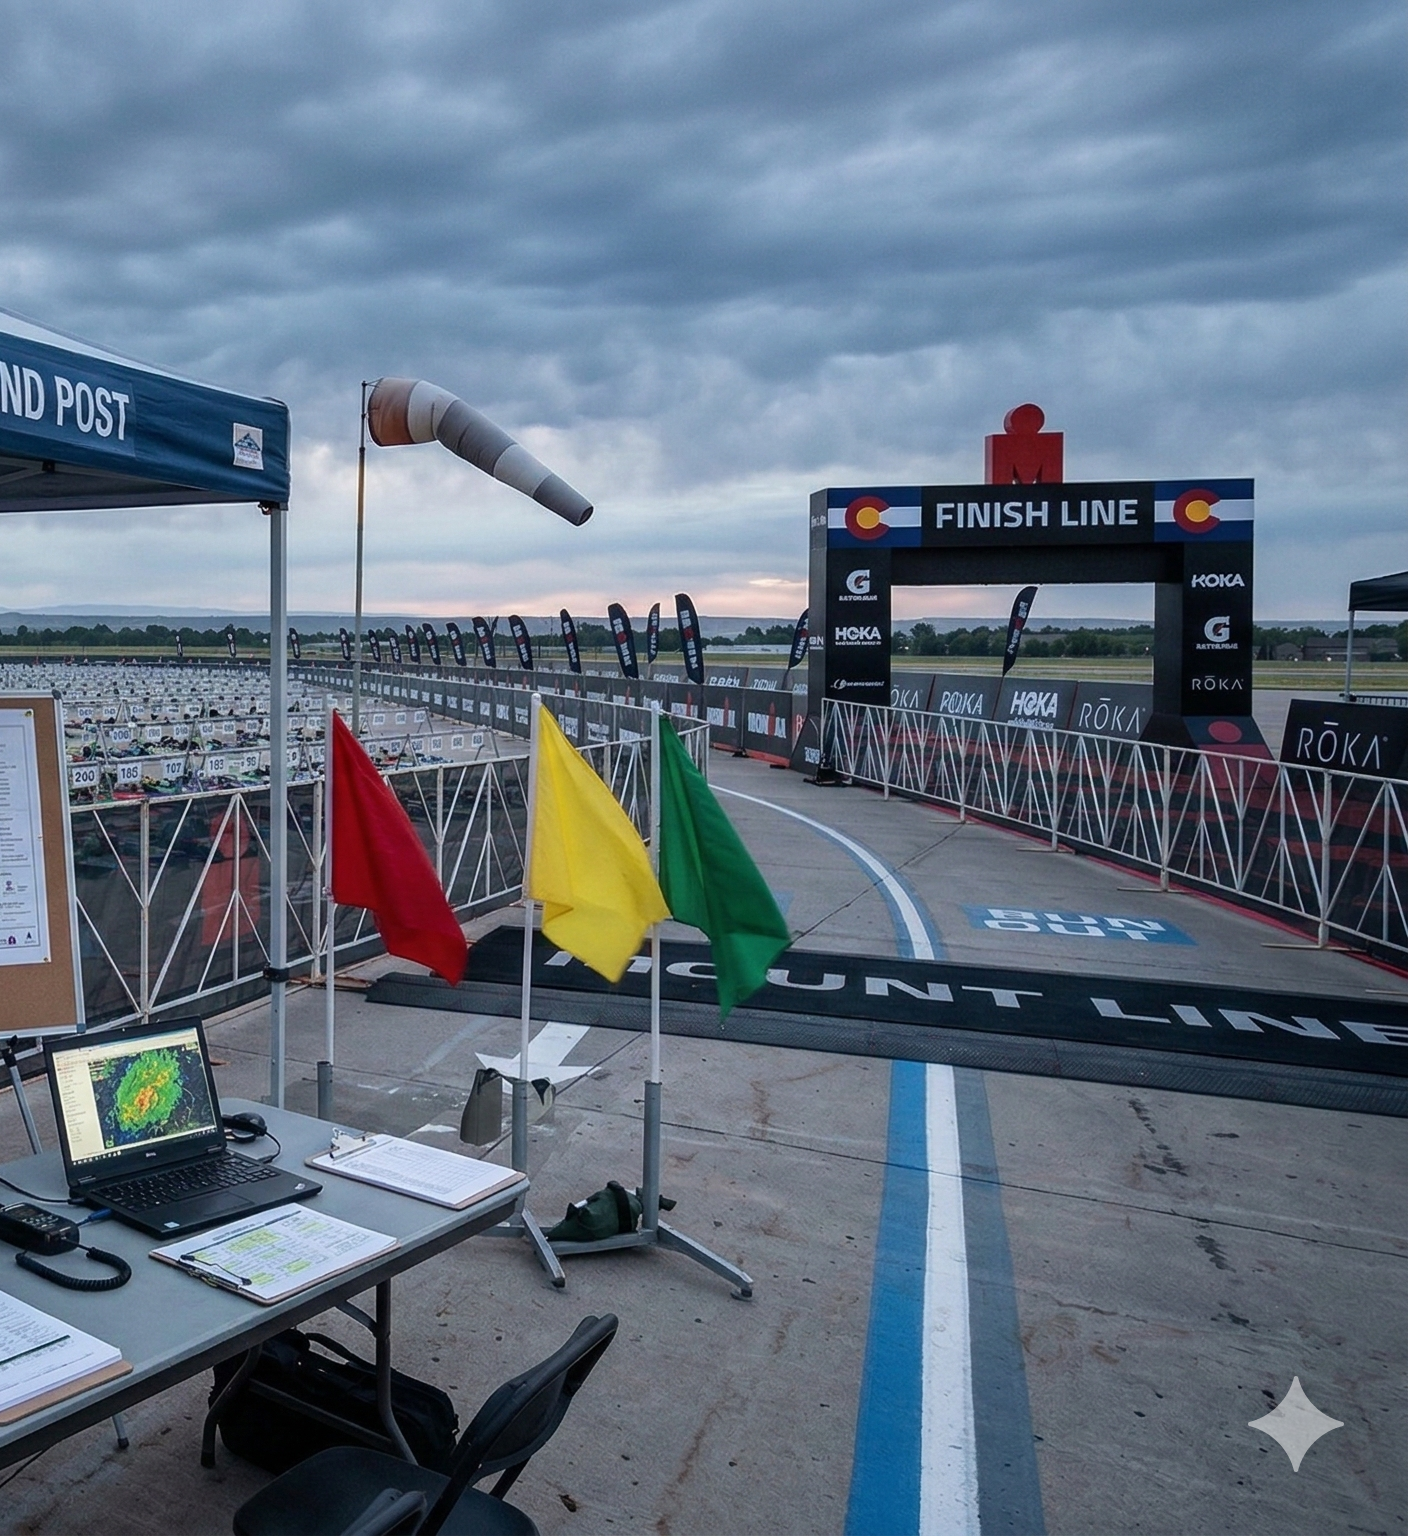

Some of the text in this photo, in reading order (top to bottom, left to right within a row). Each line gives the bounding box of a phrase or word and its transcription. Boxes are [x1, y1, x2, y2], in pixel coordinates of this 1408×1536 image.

[54, 375, 130, 441] POST
[936, 500, 1138, 528] FINISH LINE
[835, 627, 882, 641] HOKA
[75, 770, 95, 783] 200
[166, 763, 182, 774] 107
[984, 920, 1157, 941] OUT
